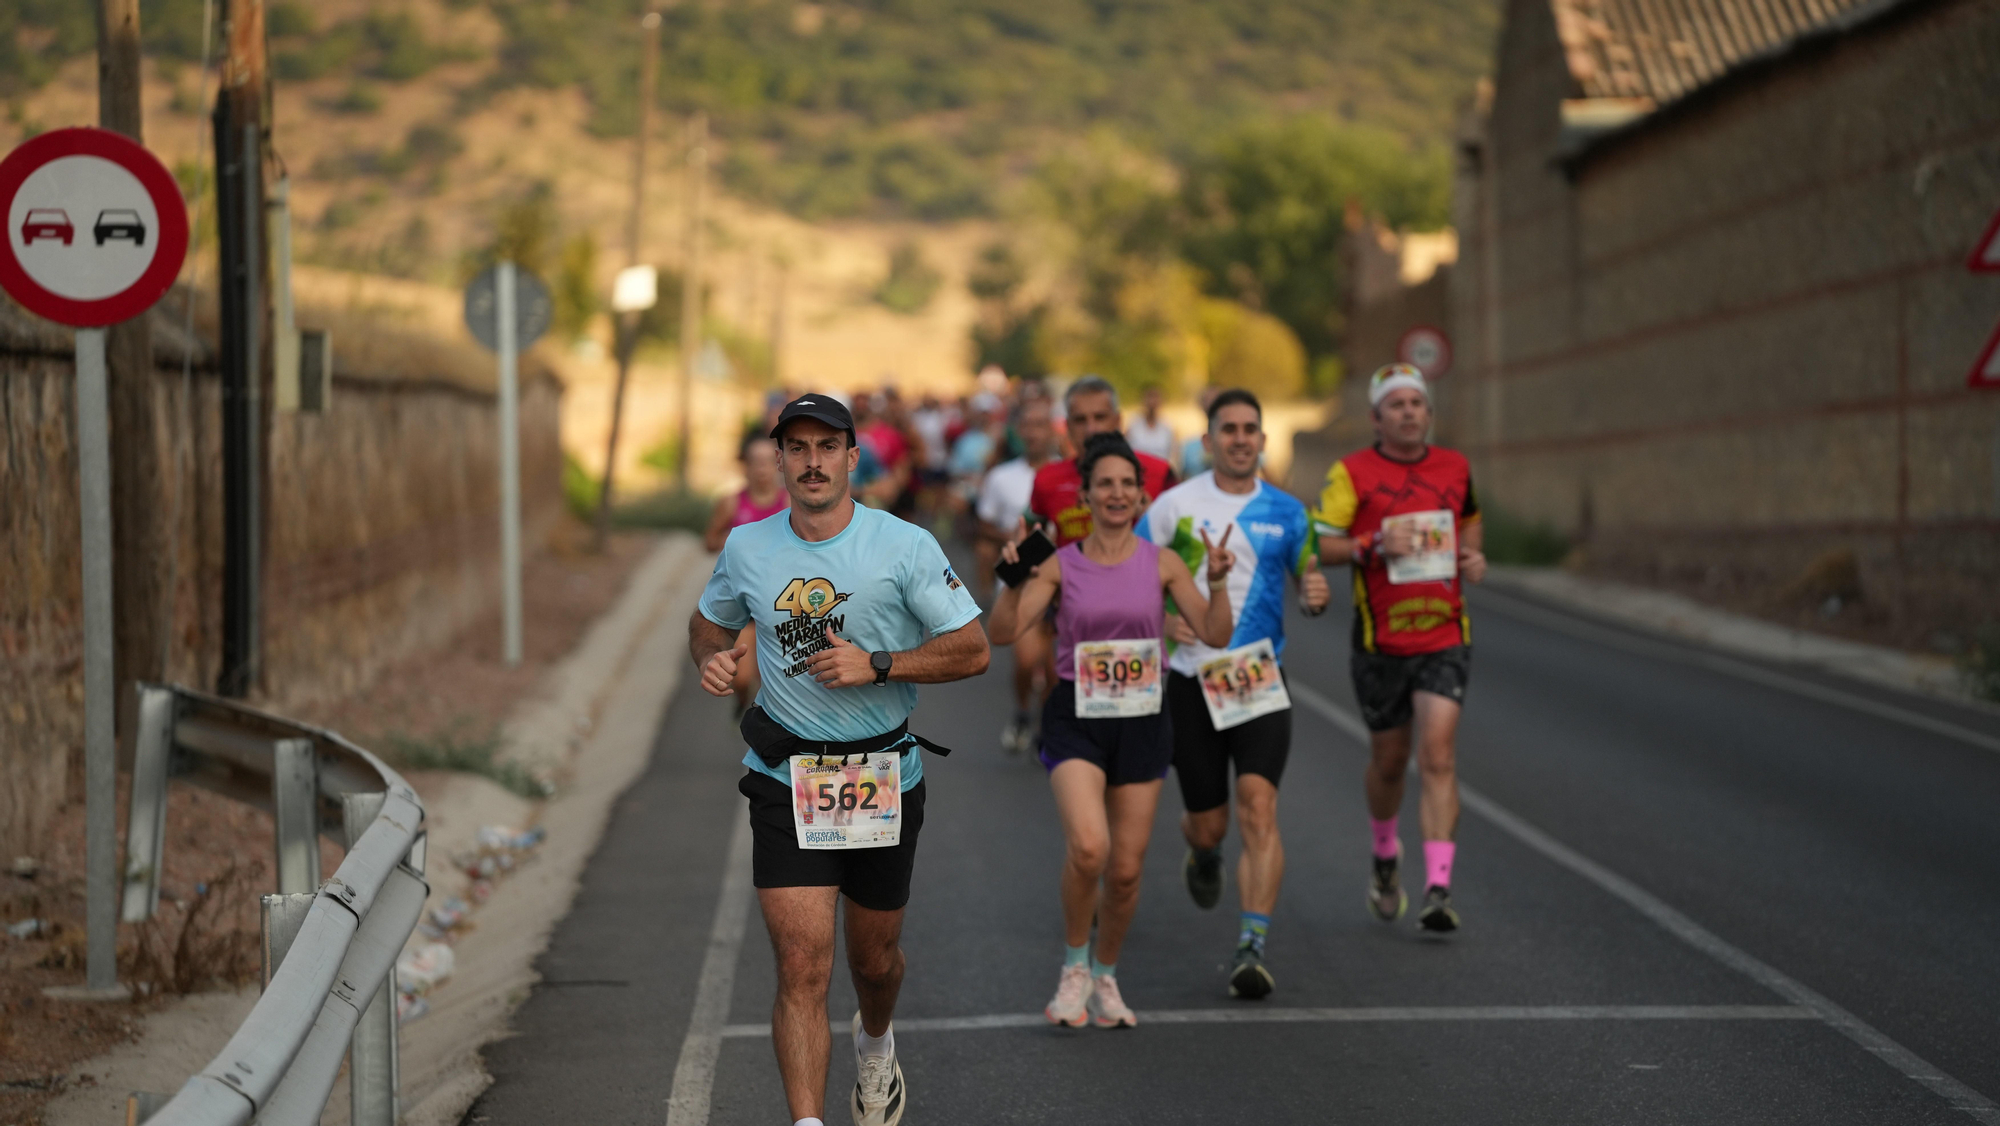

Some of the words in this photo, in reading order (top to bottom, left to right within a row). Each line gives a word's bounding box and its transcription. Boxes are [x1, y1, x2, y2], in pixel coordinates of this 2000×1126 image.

[774, 577, 846, 618] 40
[774, 614, 812, 638] MEDIA
[779, 613, 845, 657] MARATÓN
[1096, 660, 1142, 682] 309
[1221, 663, 1264, 692] 191
[818, 782, 878, 811] 562
[806, 835, 847, 843] populares
